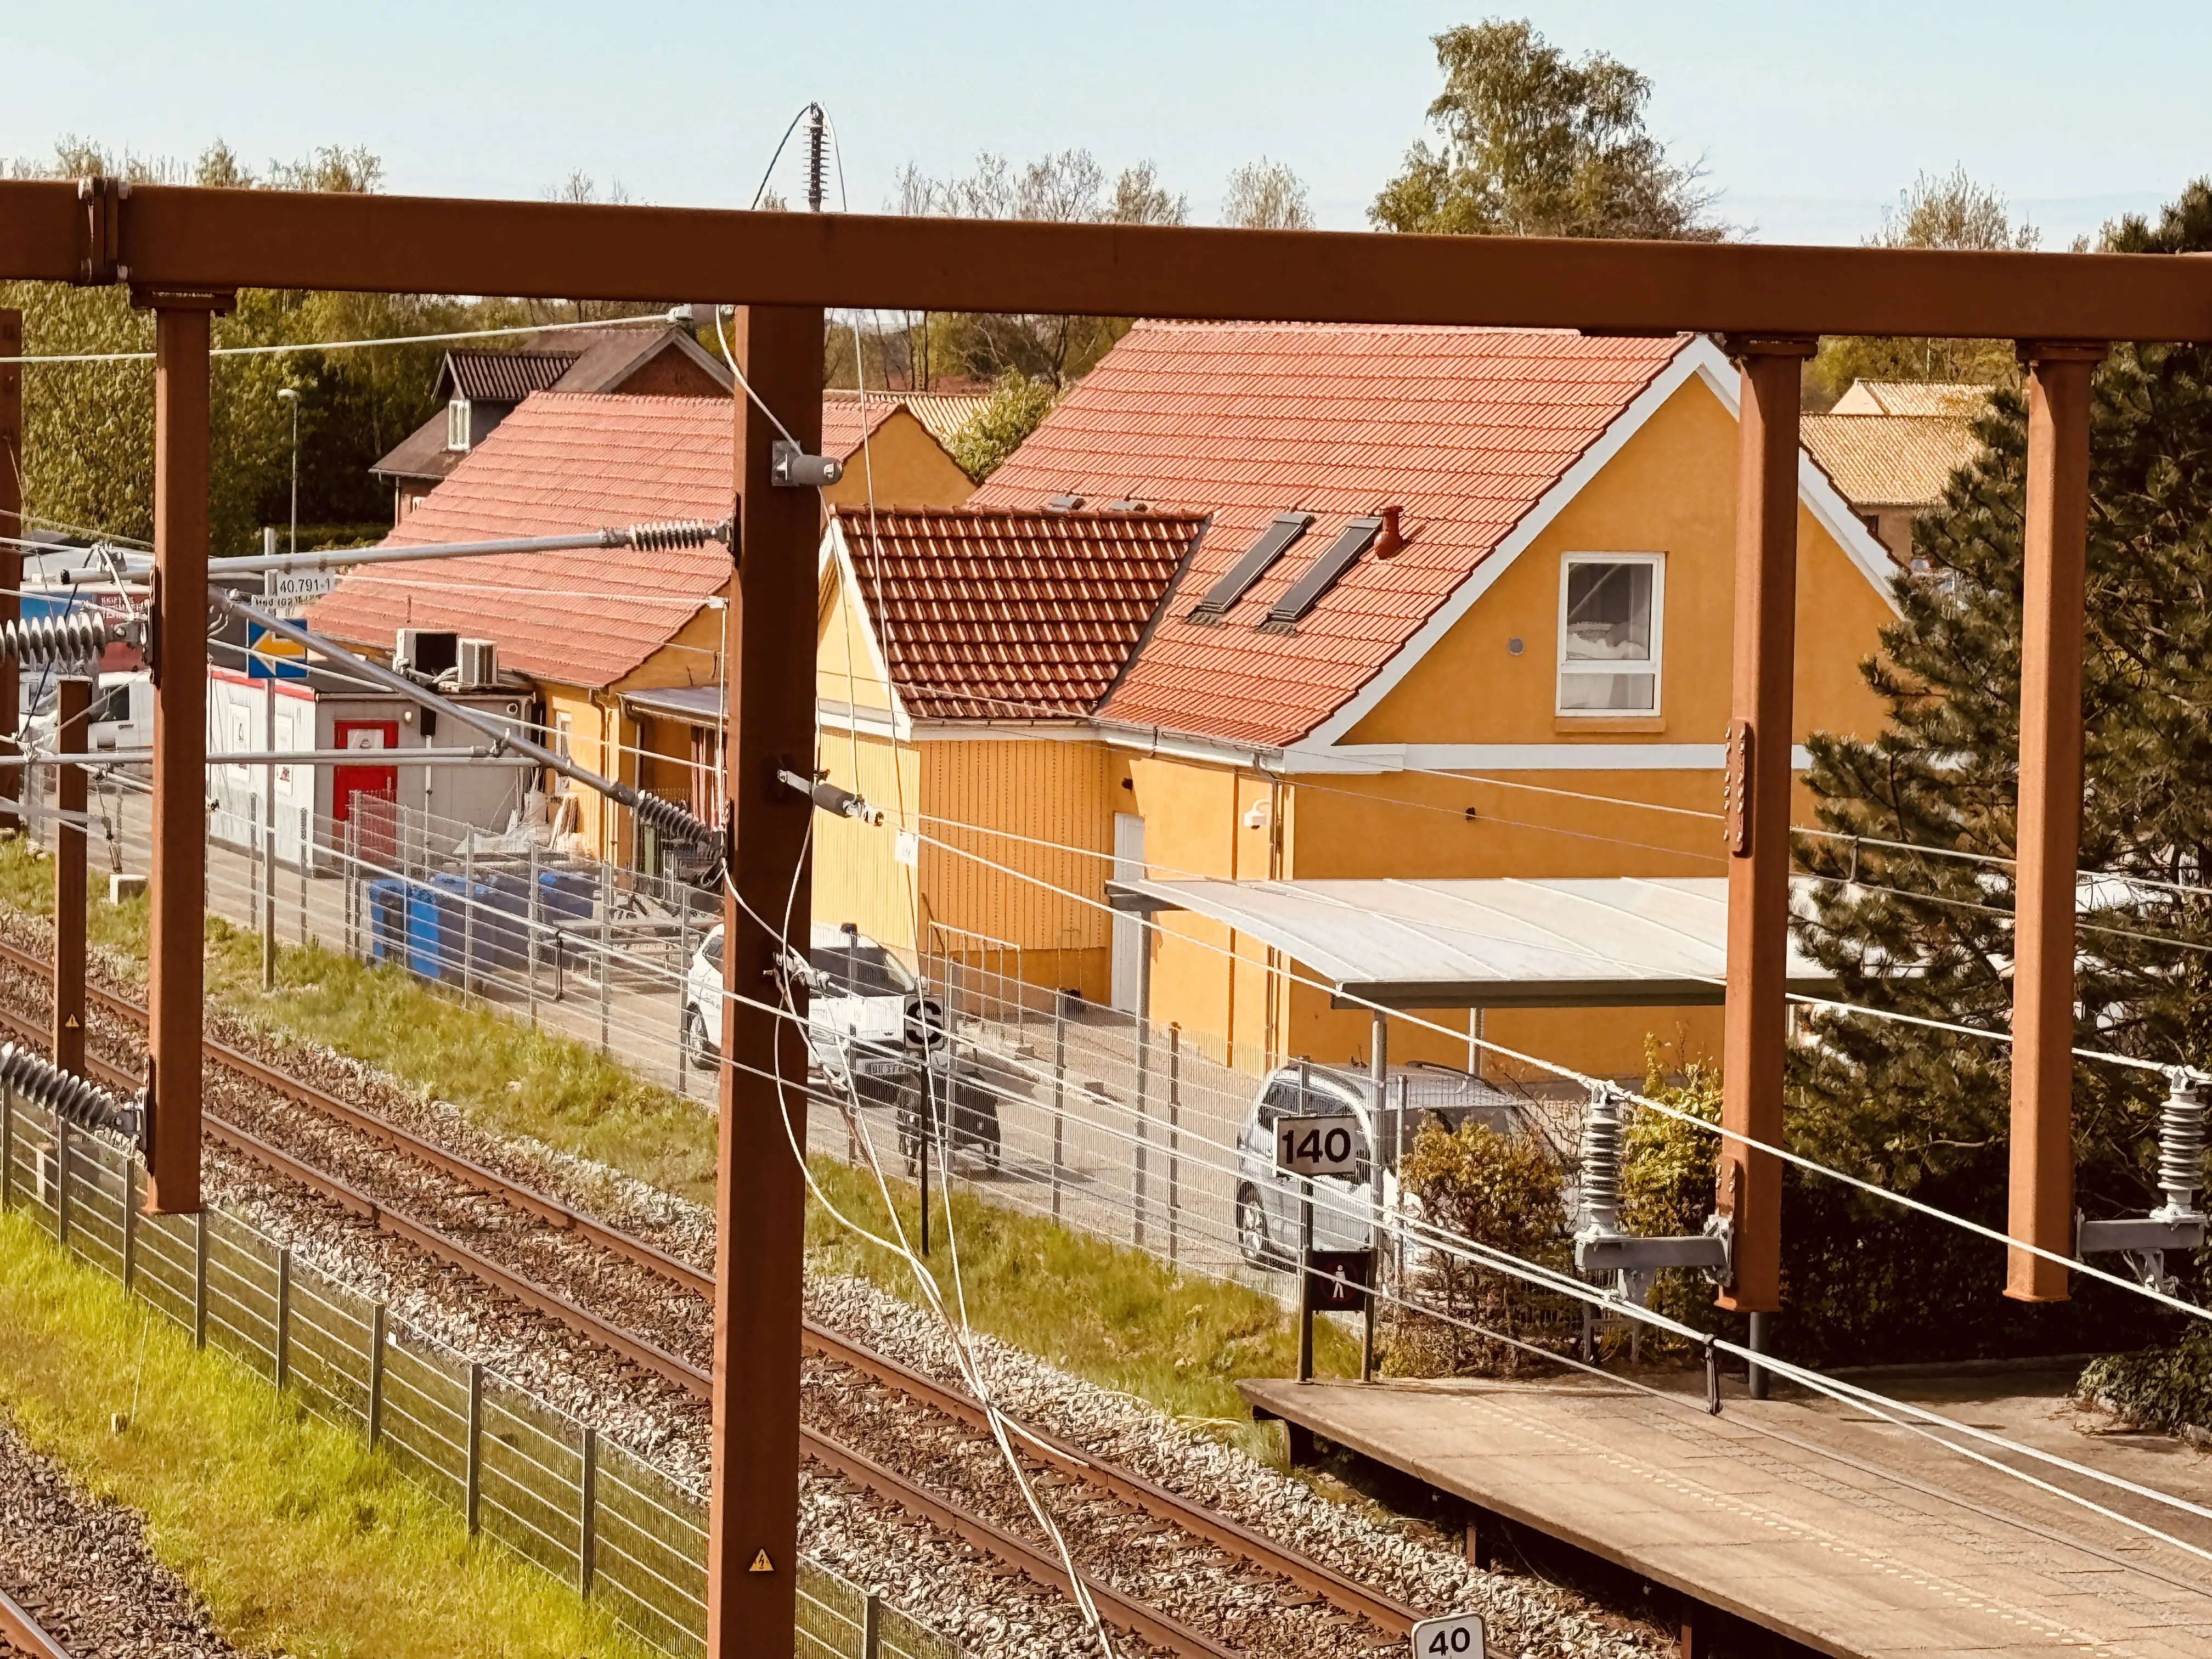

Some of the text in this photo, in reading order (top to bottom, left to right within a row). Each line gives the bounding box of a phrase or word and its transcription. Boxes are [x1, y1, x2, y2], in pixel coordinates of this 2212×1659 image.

[905, 1000, 944, 1046] S
[1282, 1127, 1351, 1164] 140
[1429, 1627, 1470, 1656] 40
